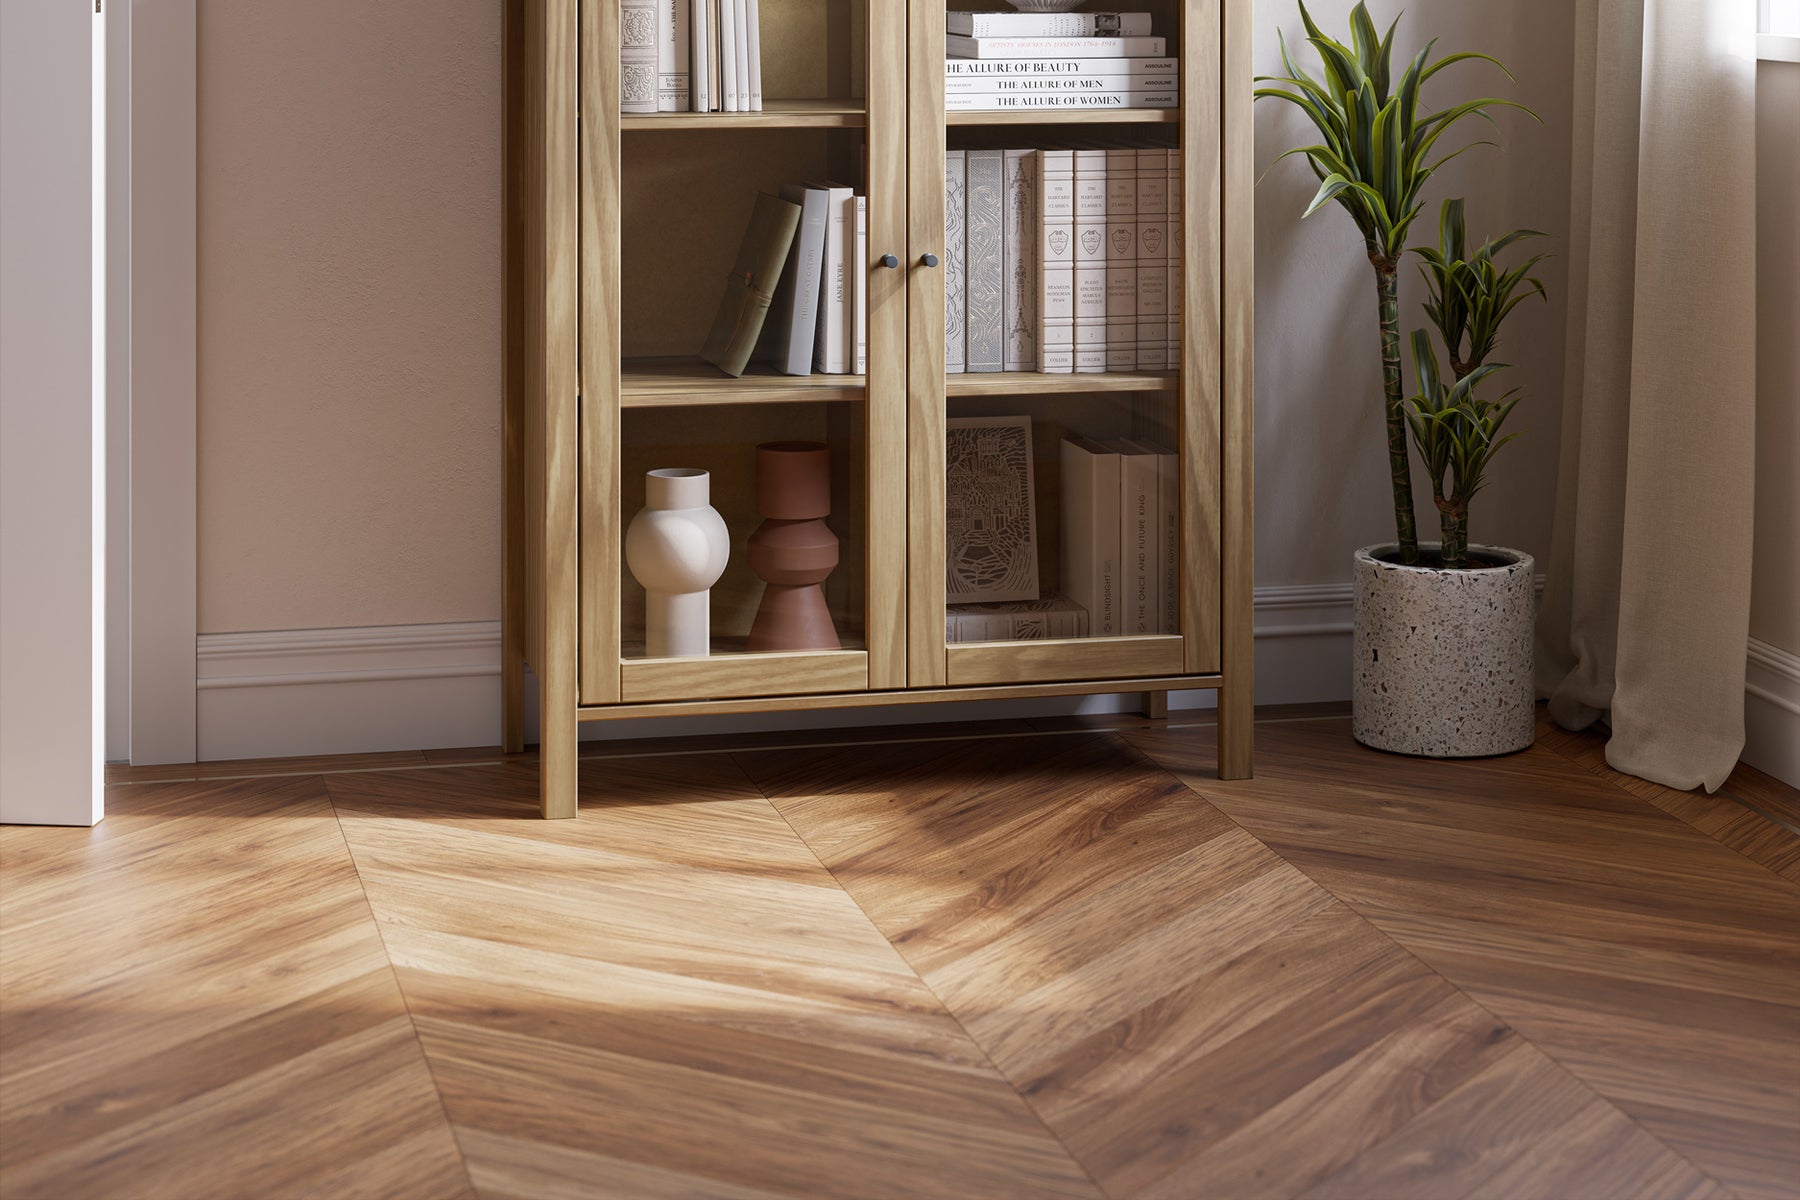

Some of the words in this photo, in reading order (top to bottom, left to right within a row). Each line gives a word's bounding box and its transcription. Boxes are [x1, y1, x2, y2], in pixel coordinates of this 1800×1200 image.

[946, 63, 963, 73] HE
[966, 63, 1012, 73] ALLURE
[1014, 62, 1030, 73] OF
[1033, 62, 1081, 72] BEAUTY
[996, 80, 1018, 89] THE
[1020, 80, 1061, 89] ALLURE
[1063, 80, 1078, 88] OF
[1080, 79, 1103, 88] MEN
[995, 97, 1018, 106] THE
[1020, 97, 1061, 106] ALLURE
[1063, 96, 1078, 105] OF
[1080, 96, 1121, 105] WOMEN
[1137, 494, 1145, 516] KING
[1137, 519, 1145, 549] FUTURE
[1137, 552, 1145, 571] AND
[1137, 575, 1145, 601] ONCE
[1103, 575, 1111, 621] BLINDSIGHT
[1137, 604, 1145, 619] THE
